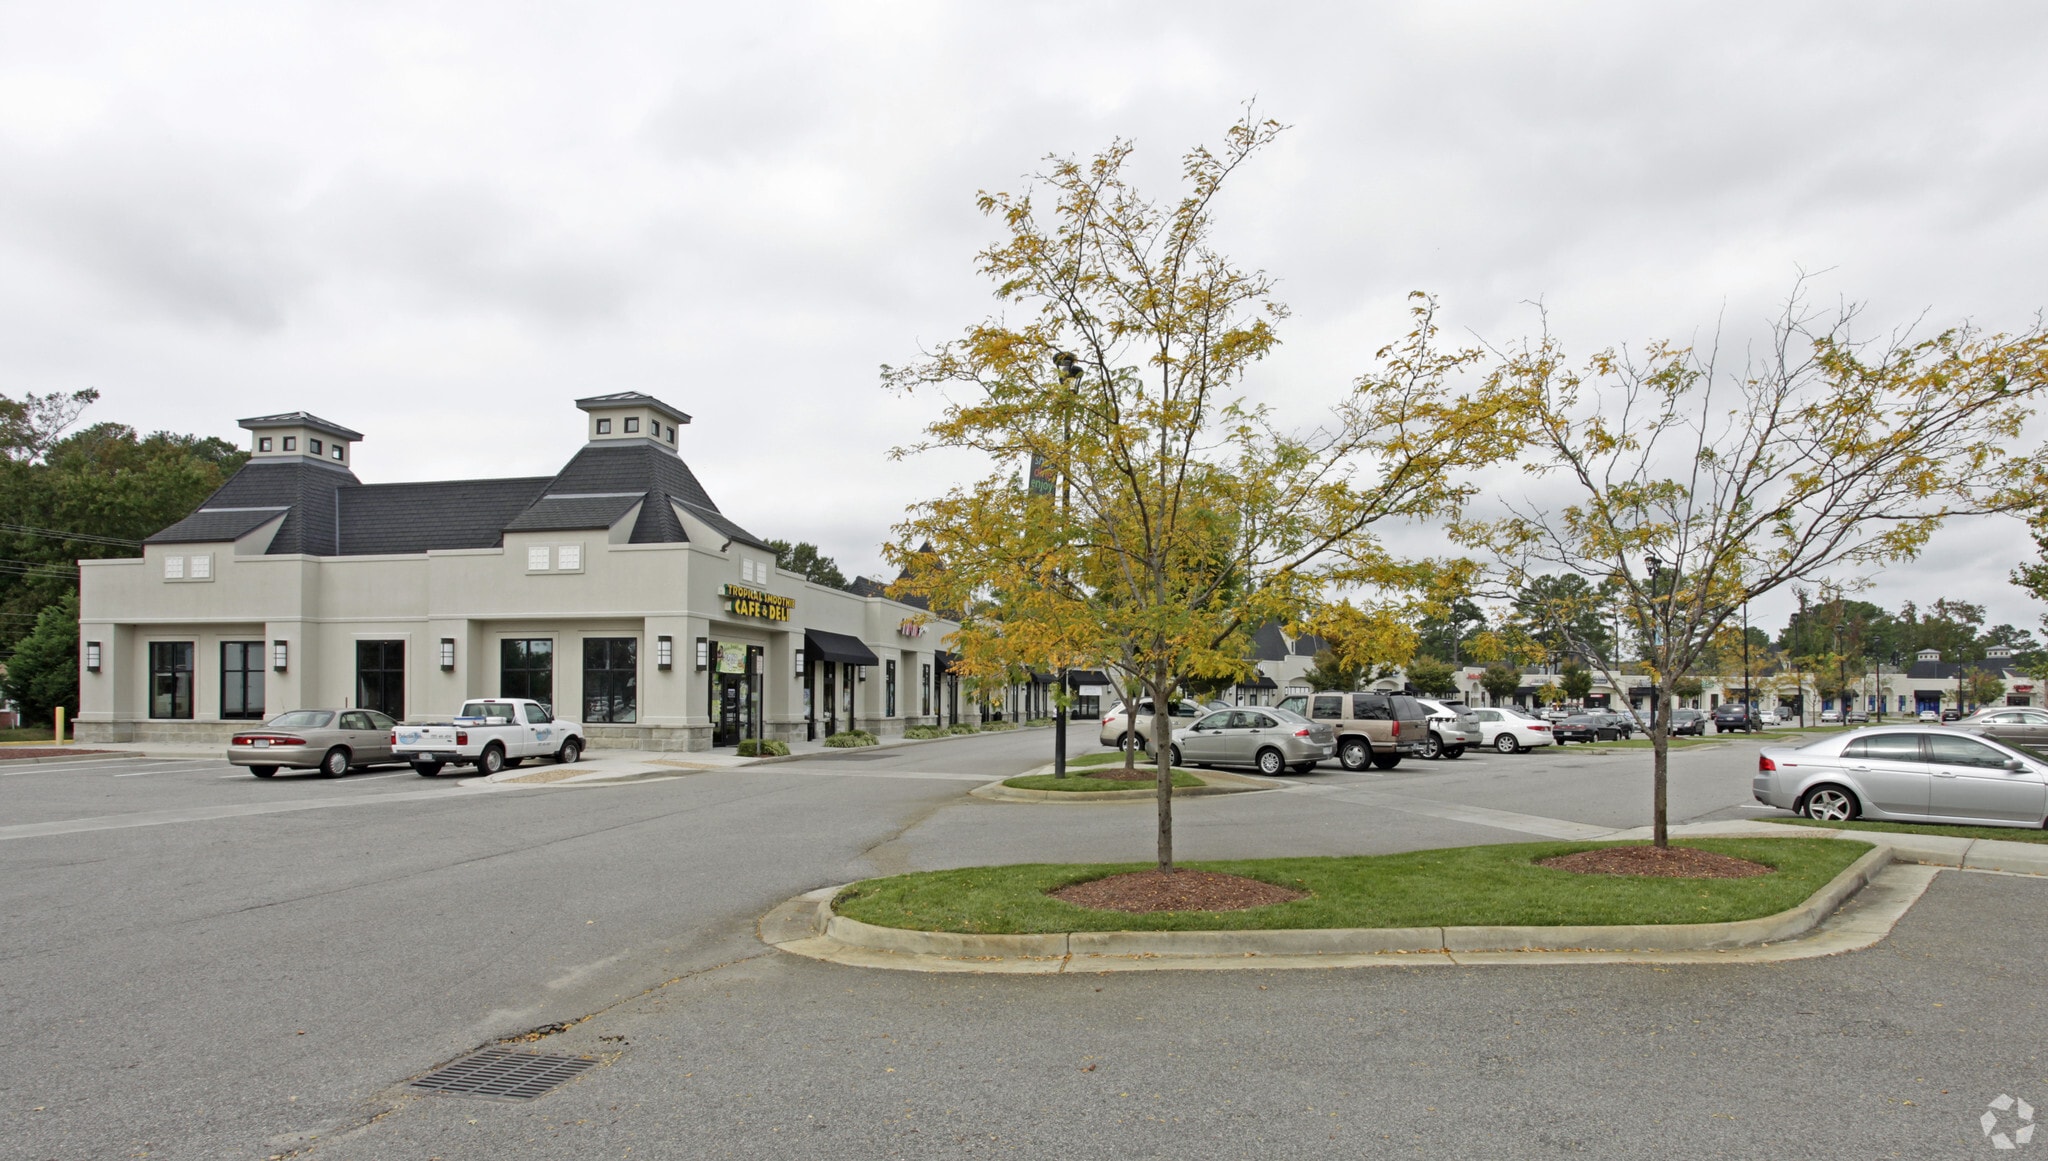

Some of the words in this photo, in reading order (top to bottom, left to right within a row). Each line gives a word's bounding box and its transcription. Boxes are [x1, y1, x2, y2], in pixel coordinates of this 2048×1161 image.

[1031, 479, 1053, 493] enjoy
[728, 584, 762, 601] TROPICAL
[764, 592, 796, 609] SMOOTHIE
[734, 599, 760, 617] CAFE
[761, 604, 768, 616] &
[769, 605, 790, 622] DELI
